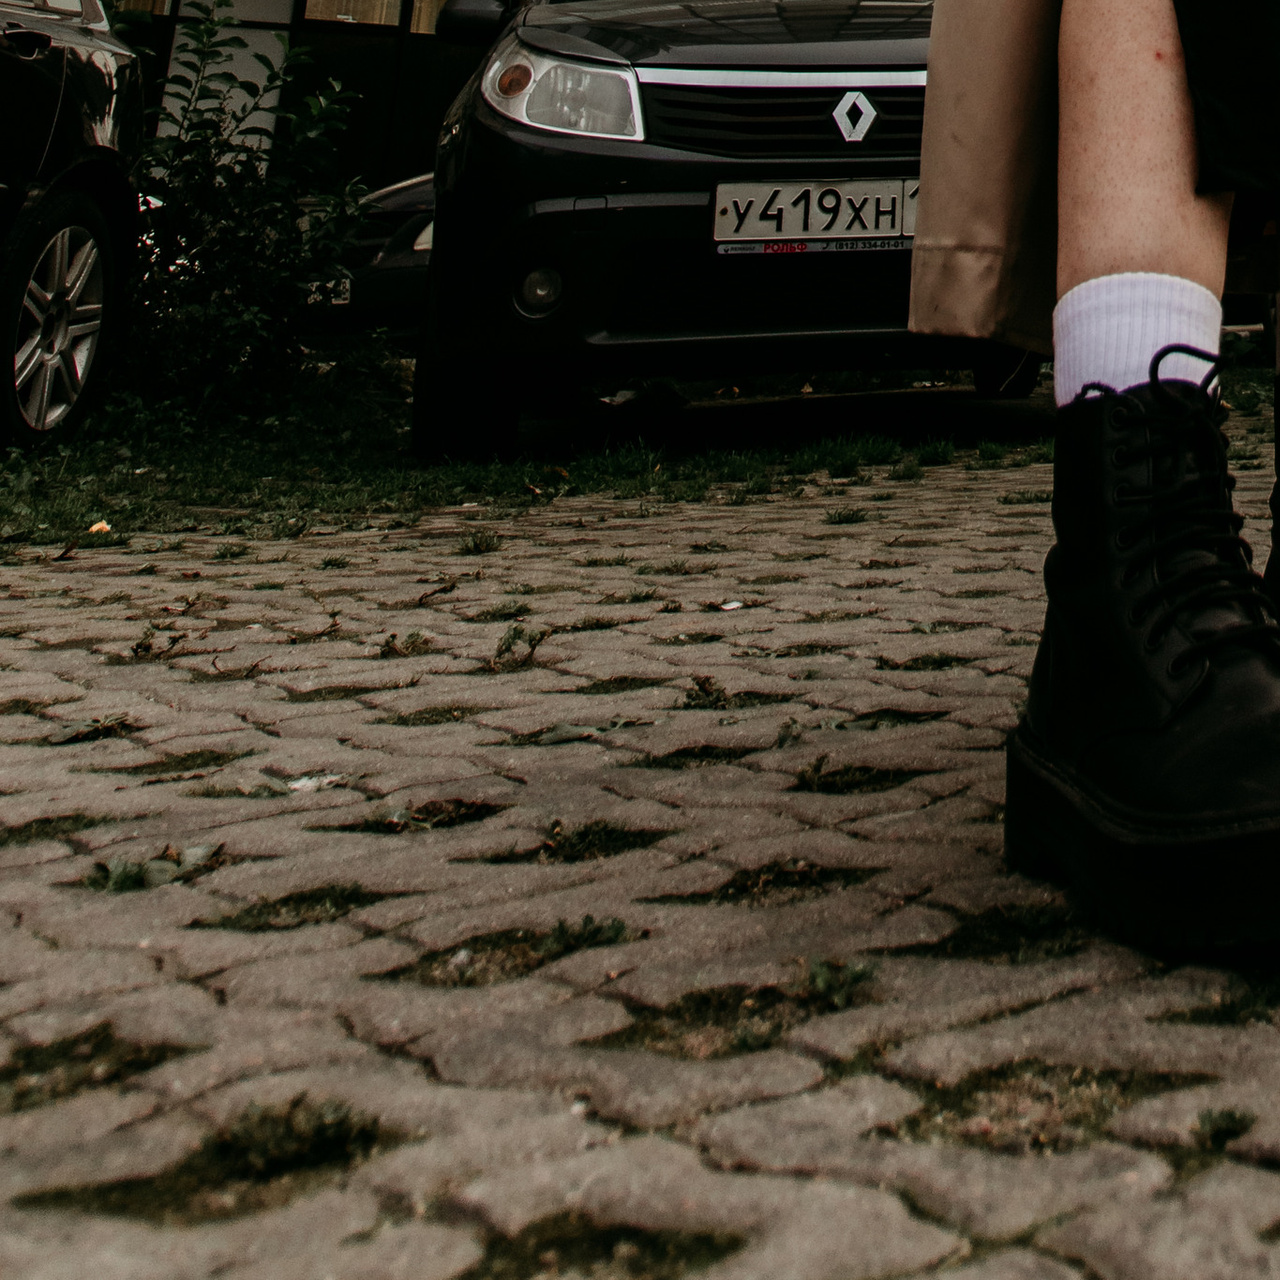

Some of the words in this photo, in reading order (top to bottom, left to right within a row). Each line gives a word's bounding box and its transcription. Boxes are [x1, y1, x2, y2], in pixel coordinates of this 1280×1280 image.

[732, 187, 897, 233] У419ХН
[763, 243, 808, 254] РОЛЬФ
[834, 241, 859, 251] (812)
[861, 240, 905, 250] 334-01-01
